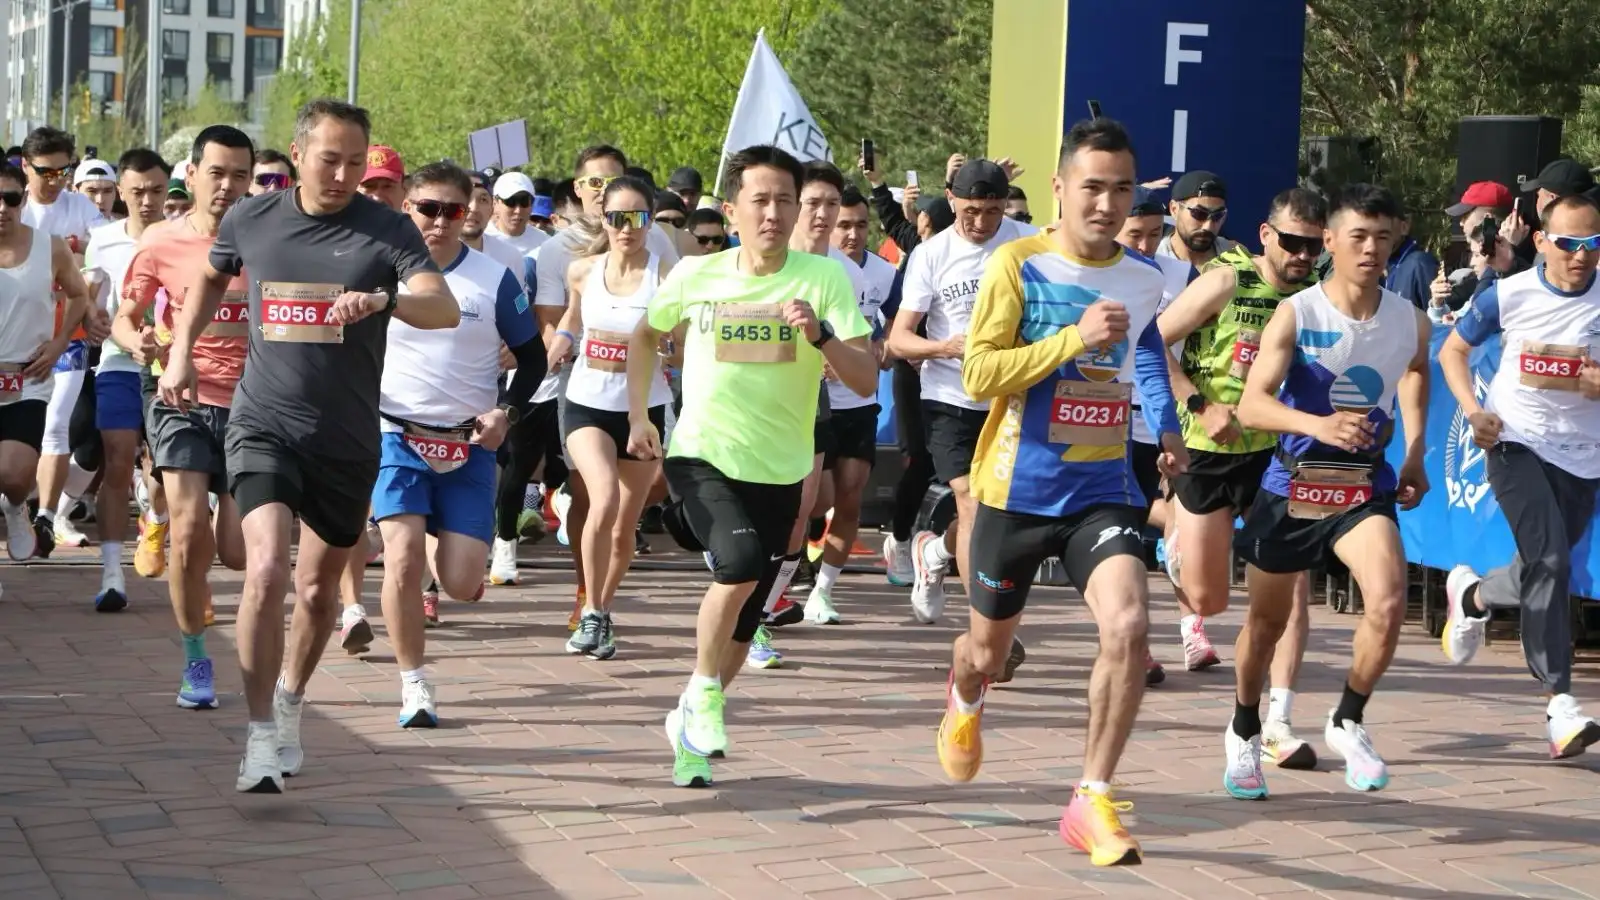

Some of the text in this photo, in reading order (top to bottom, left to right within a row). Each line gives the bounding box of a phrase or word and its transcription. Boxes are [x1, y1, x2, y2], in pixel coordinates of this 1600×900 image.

[1163, 22, 1209, 173] FI
[238, 307, 249, 321] A
[267, 304, 317, 323] 5056
[1235, 311, 1265, 327] JUST
[721, 325, 792, 341] 5453 B
[589, 343, 627, 361] 5074
[1524, 358, 1571, 376] 5043
[9, 378, 20, 391] A
[1057, 403, 1124, 425] 5023 A
[452, 447, 465, 460] A
[1296, 486, 1366, 504] 5076 A
